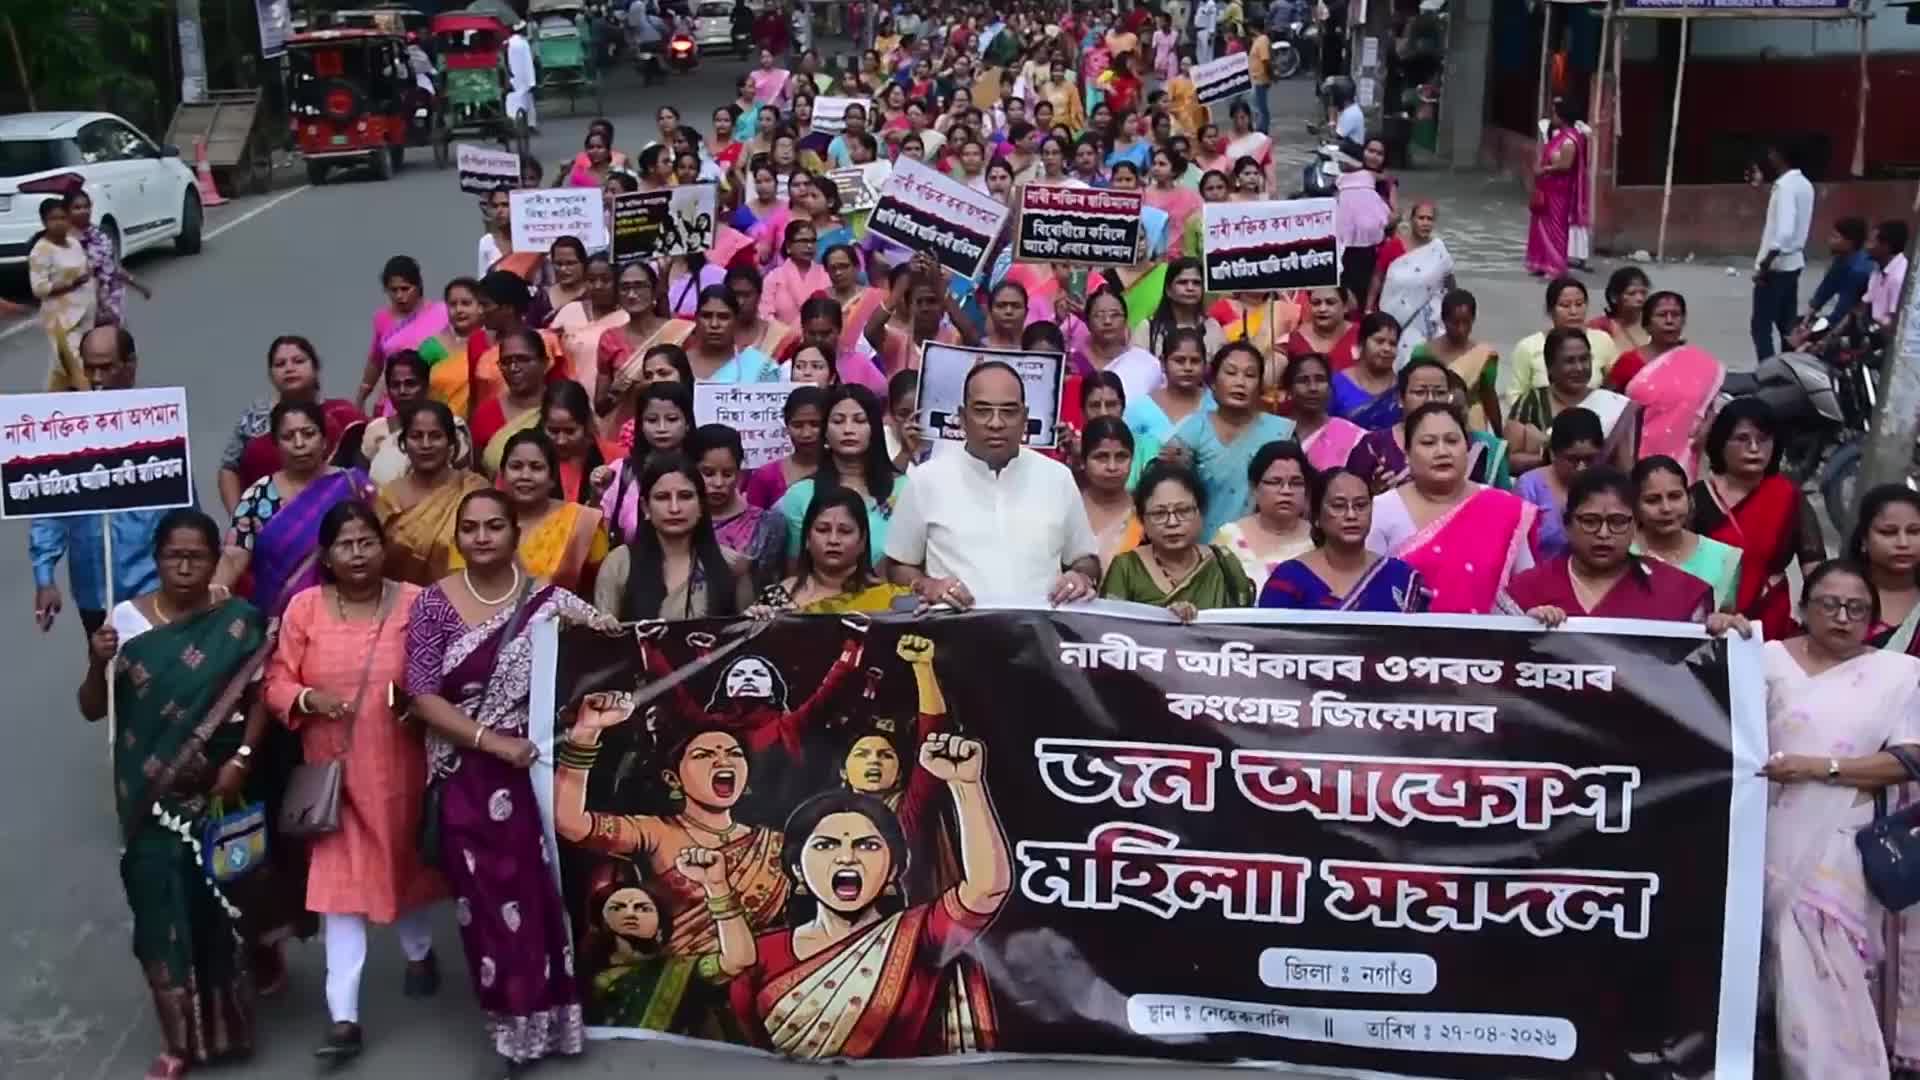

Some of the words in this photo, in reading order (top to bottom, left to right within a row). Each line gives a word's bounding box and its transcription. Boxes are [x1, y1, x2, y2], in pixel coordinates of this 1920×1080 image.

[4, 414, 37, 445] নাৰী
[40, 408, 92, 441] শক্তিক
[94, 407, 124, 433] কৰা
[127, 402, 180, 428] অপমান
[1035, 737, 1222, 812] জন
[1231, 749, 1640, 833] আক্ৰোশ
[1320, 859, 1660, 940] সমদল
[1285, 954, 1332, 984] জিলা
[1360, 960, 1413, 987] নগাঁও
[1439, 1024, 1558, 1047] ২৭-০৪-২০২৬
